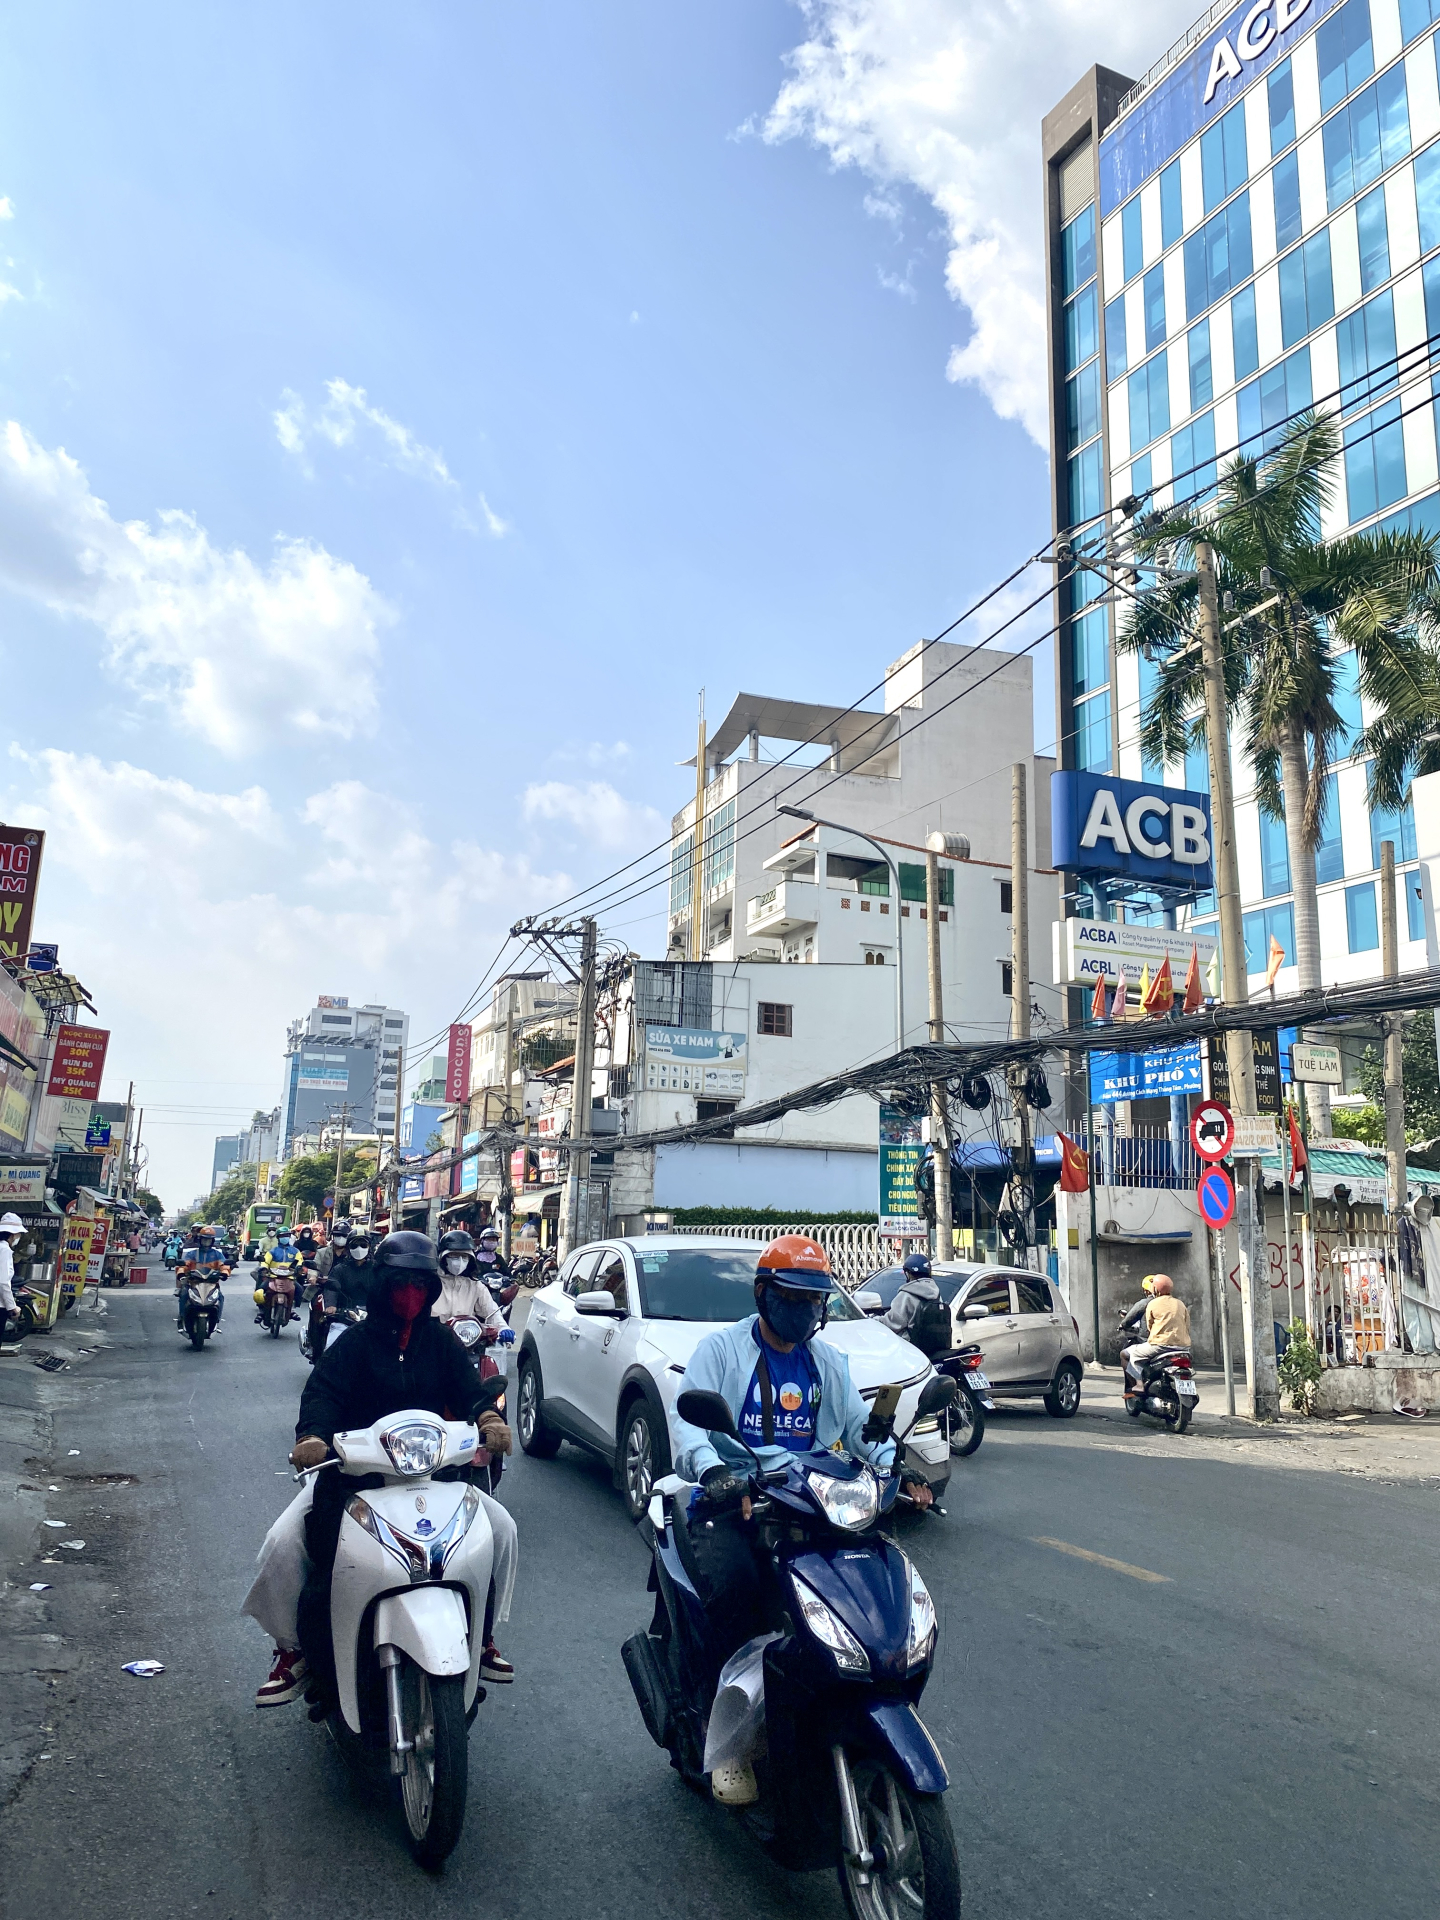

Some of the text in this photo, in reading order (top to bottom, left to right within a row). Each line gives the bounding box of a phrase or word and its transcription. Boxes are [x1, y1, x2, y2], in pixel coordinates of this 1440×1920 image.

[1080, 789, 1211, 864] ACB
[0, 875, 27, 893] M
[0, 901, 23, 934] Y
[1079, 927, 1117, 944] ACBA
[1122, 932, 1136, 940] Công
[1143, 936, 1156, 944] quản
[1136, 942, 1164, 951] Management
[1080, 959, 1116, 975] ACBL
[1122, 963, 1137, 972] Công
[332, 998, 348, 1007] MB
[649, 1030, 713, 1047] SỬA XE NAM
[1252, 1036, 1272, 1056] ÂM
[69, 1047, 90, 1057] 30K
[452, 1027, 470, 1098] concung
[1145, 1057, 1172, 1068] KHU
[1299, 1057, 1338, 1072] TUỆ LÂM
[66, 1067, 86, 1076] 35K
[1261, 1066, 1275, 1075] SINH
[1104, 1064, 1201, 1090] KHU PHỐ V
[62, 1086, 83, 1095] 35K
[1258, 1094, 1275, 1105] FOOT
[888, 1150, 918, 1159] THÔNG TIN
[888, 1190, 901, 1199] CHO
[888, 1203, 901, 1213] TIÊU
[22, 1216, 33, 1226] ÁNH
[77, 1226, 91, 1238] CUA
[796, 1255, 823, 1264] Ahamove
[64, 1262, 80, 1273] 5K
[62, 1283, 77, 1293] 5K
[744, 1413, 815, 1429] NELÉ CA
